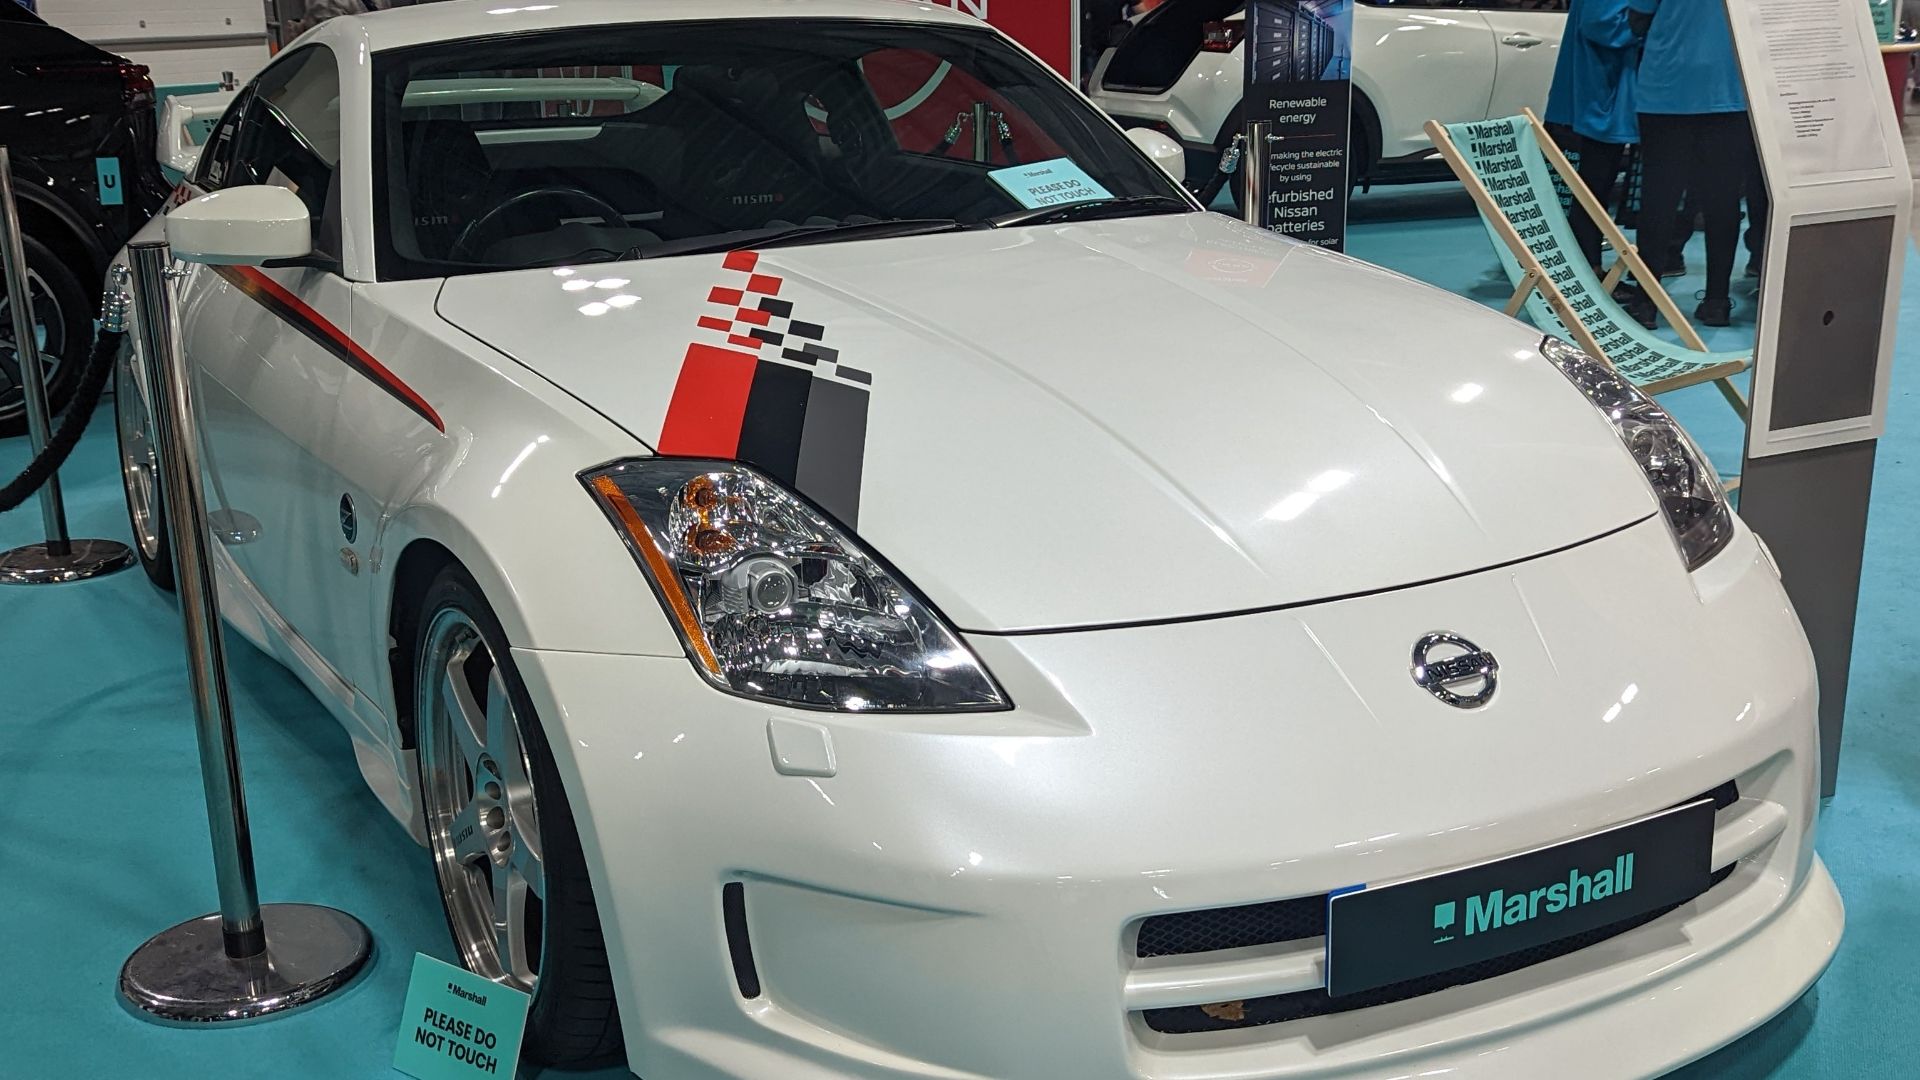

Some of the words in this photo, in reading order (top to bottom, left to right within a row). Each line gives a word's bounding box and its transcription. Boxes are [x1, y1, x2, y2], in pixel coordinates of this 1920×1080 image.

[1269, 96, 1327, 109] Renewable
[1280, 113, 1316, 125] energy
[1473, 120, 1515, 139] Marshall
[1270, 151, 1300, 160] making
[1301, 150, 1314, 158] the
[1315, 148, 1343, 157] electric
[1478, 137, 1518, 157] Marshall
[1296, 160, 1340, 169] sustainable
[1482, 154, 1524, 175] Marshall
[1027, 181, 1067, 196] PLEASE
[1064, 179, 1081, 189] DO
[1279, 174, 1290, 183] by
[1290, 173, 1312, 182] using
[1487, 170, 1530, 191] Marshall
[1035, 194, 1059, 206] NOT
[1057, 187, 1096, 201] TOUCH
[1268, 187, 1334, 203] furbished
[1274, 206, 1318, 219] Nissan
[1516, 219, 1550, 240] arshall
[1320, 238, 1339, 246] solar
[1528, 234, 1559, 255] rshall
[1550, 265, 1576, 284] shall
[1560, 280, 1586, 298] shall
[1570, 294, 1597, 313] shall
[1590, 320, 1621, 340] rshall
[1600, 332, 1635, 353] arshall
[1464, 852, 1634, 936] Marshall
[452, 984, 487, 1007] Marshall
[423, 1007, 473, 1040] PLEASE
[474, 1027, 497, 1049] DO
[415, 1026, 445, 1051] NOT
[447, 1040, 497, 1074] TOUCH
